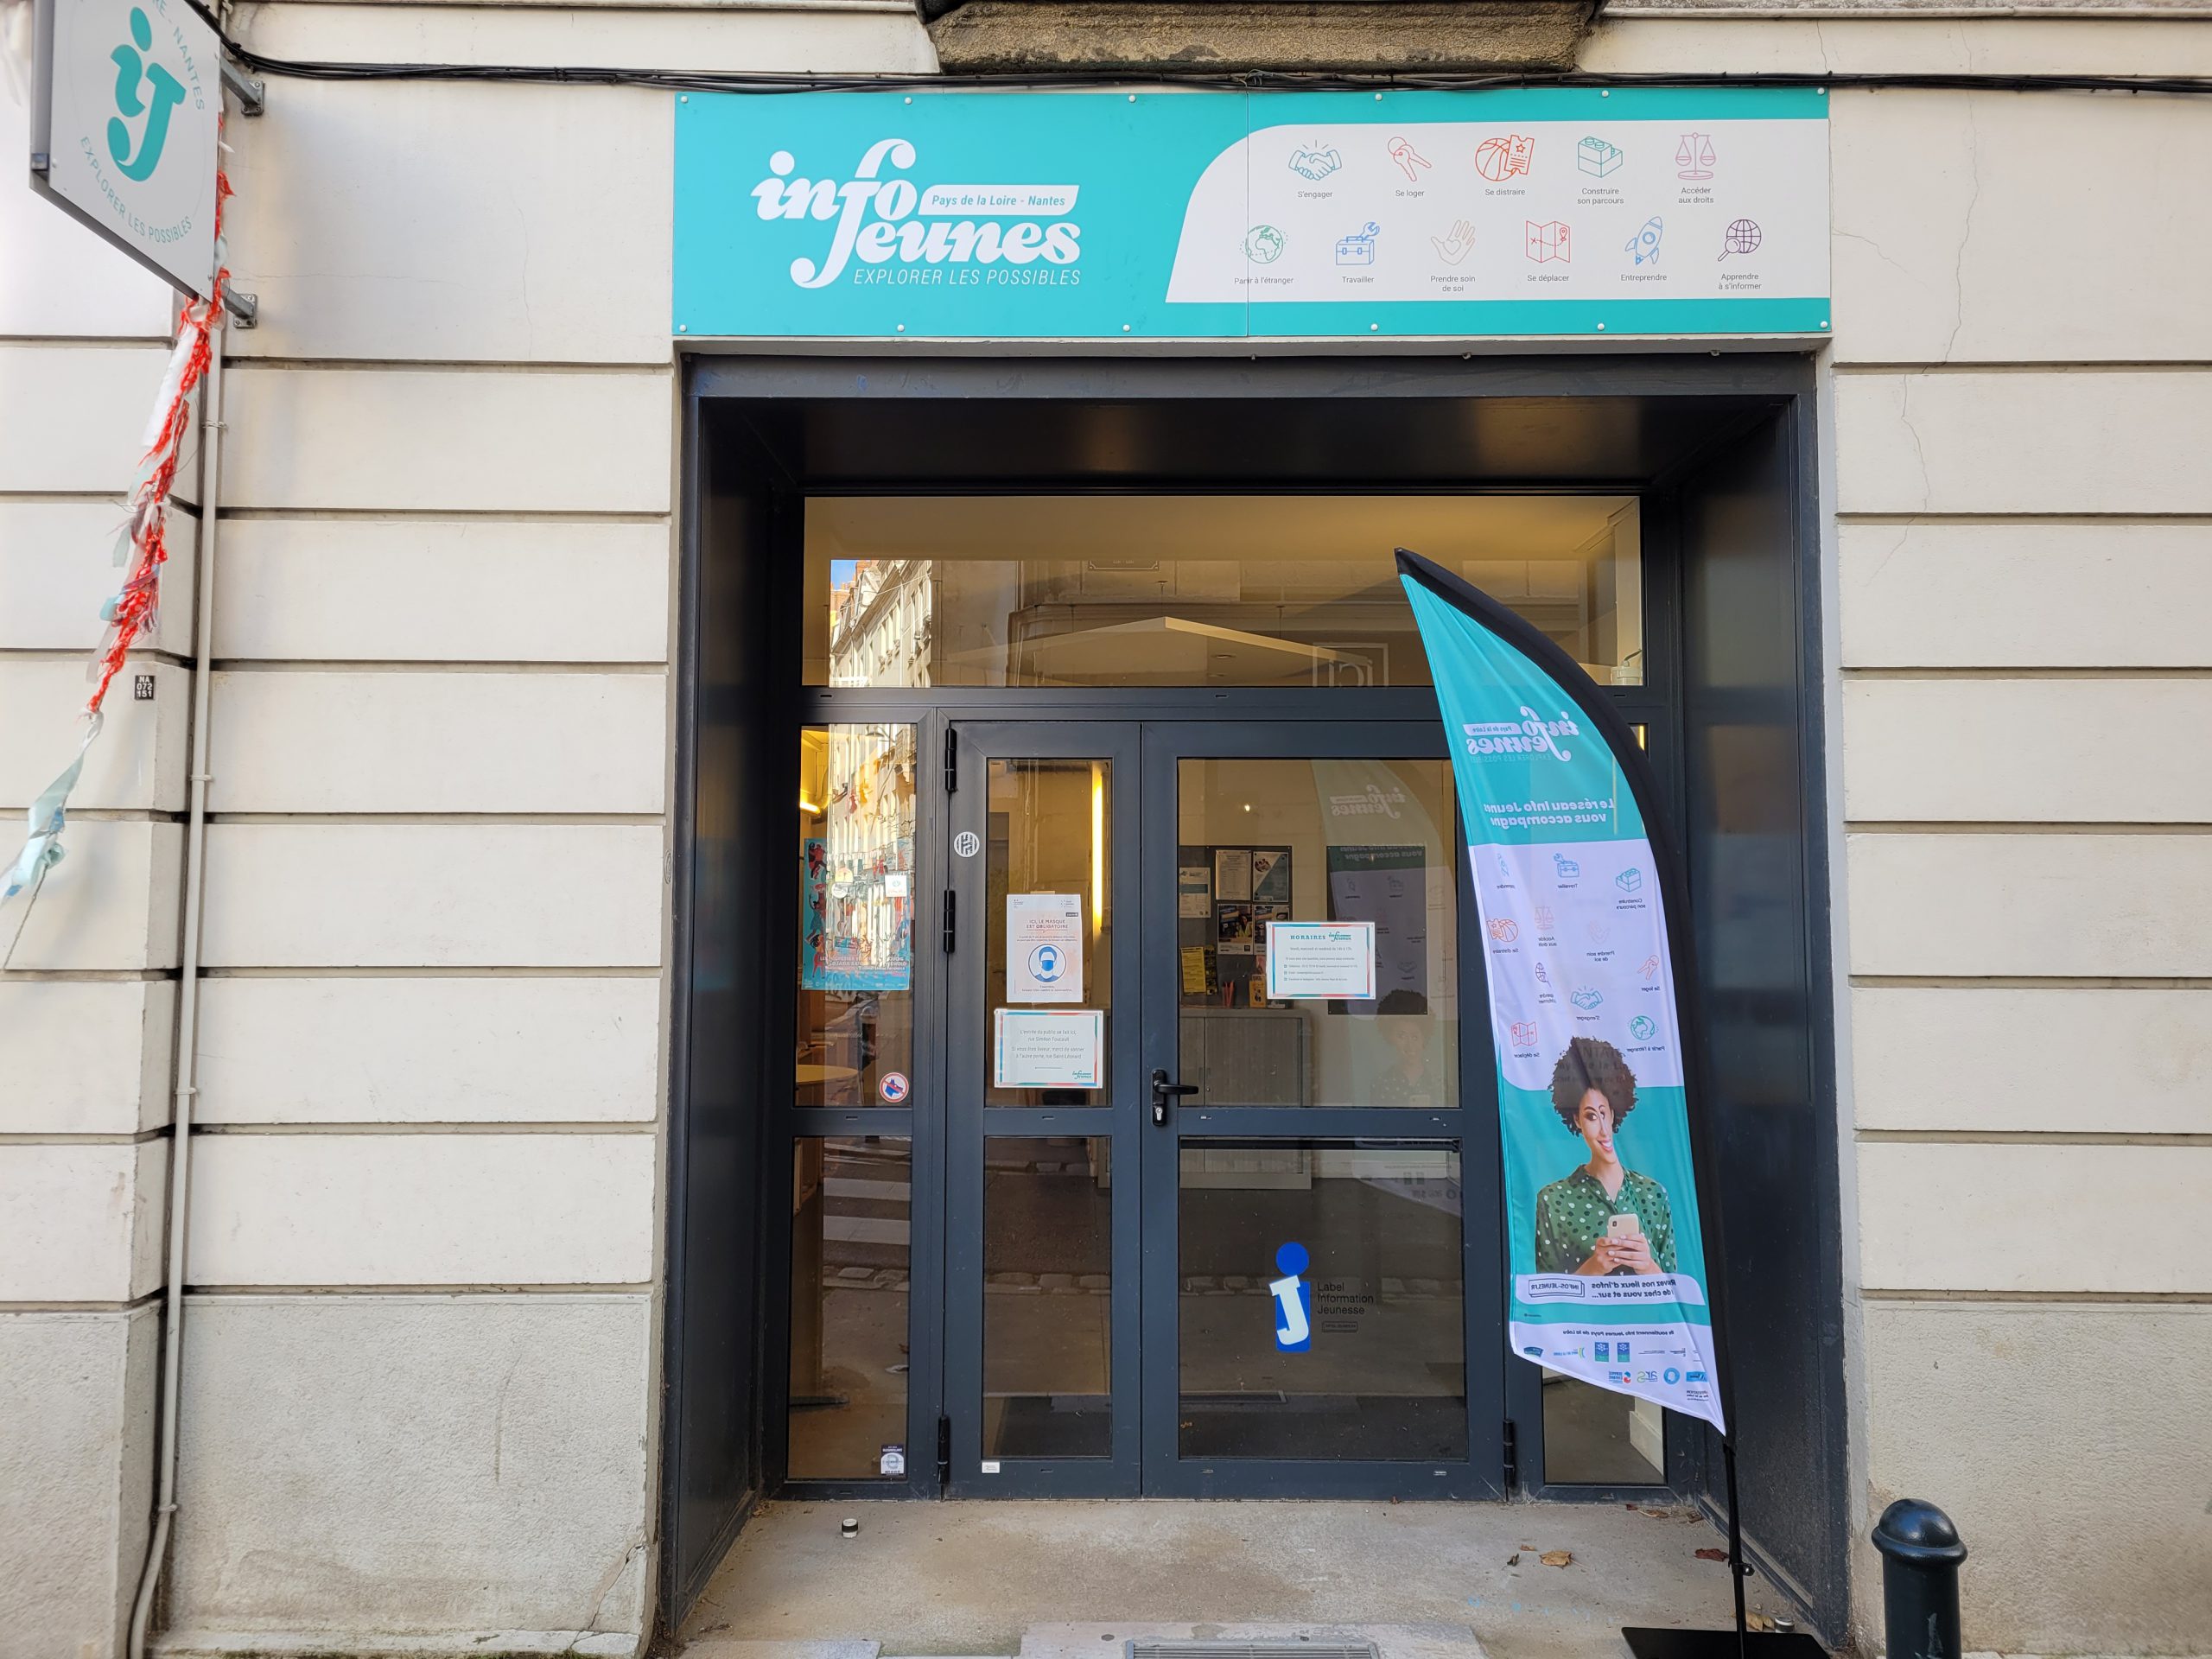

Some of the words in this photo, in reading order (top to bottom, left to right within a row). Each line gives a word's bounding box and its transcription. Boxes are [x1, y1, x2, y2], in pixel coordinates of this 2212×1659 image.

[173, 26, 206, 111] NANTES
[750, 138, 918, 221] info
[79, 136, 126, 219] EXPLORER
[128, 212, 146, 237] LES
[148, 215, 193, 244] POSSIBLES
[1297, 189, 1333, 200] S'engager
[1406, 188, 1425, 200] loger
[1496, 188, 1526, 196] distraire
[1681, 186, 1712, 194] Accéder
[931, 194, 958, 207] Pays
[960, 195, 974, 206] de
[976, 194, 987, 206] la
[989, 195, 1017, 207] Loire
[1027, 195, 1065, 207] Nantes
[1592, 197, 1624, 206] parcours
[1693, 195, 1714, 204] droits
[854, 269, 942, 285] EXPLORER
[949, 269, 981, 285] LES
[986, 269, 1081, 285] POSSIBLES
[1261, 276, 1294, 286] l'étranger
[1459, 274, 1476, 283] soin
[1537, 273, 1570, 283] déplacer
[1620, 273, 1668, 283] Entreprendre
[1720, 272, 1759, 283] Apprendre
[1441, 283, 1452, 292] de
[1452, 283, 1465, 292] soi
[1724, 282, 1763, 290] s'informer
[1317, 1281, 1344, 1292] Label
[1317, 1293, 1375, 1304] Information
[1317, 1305, 1365, 1315] Jeunesse
